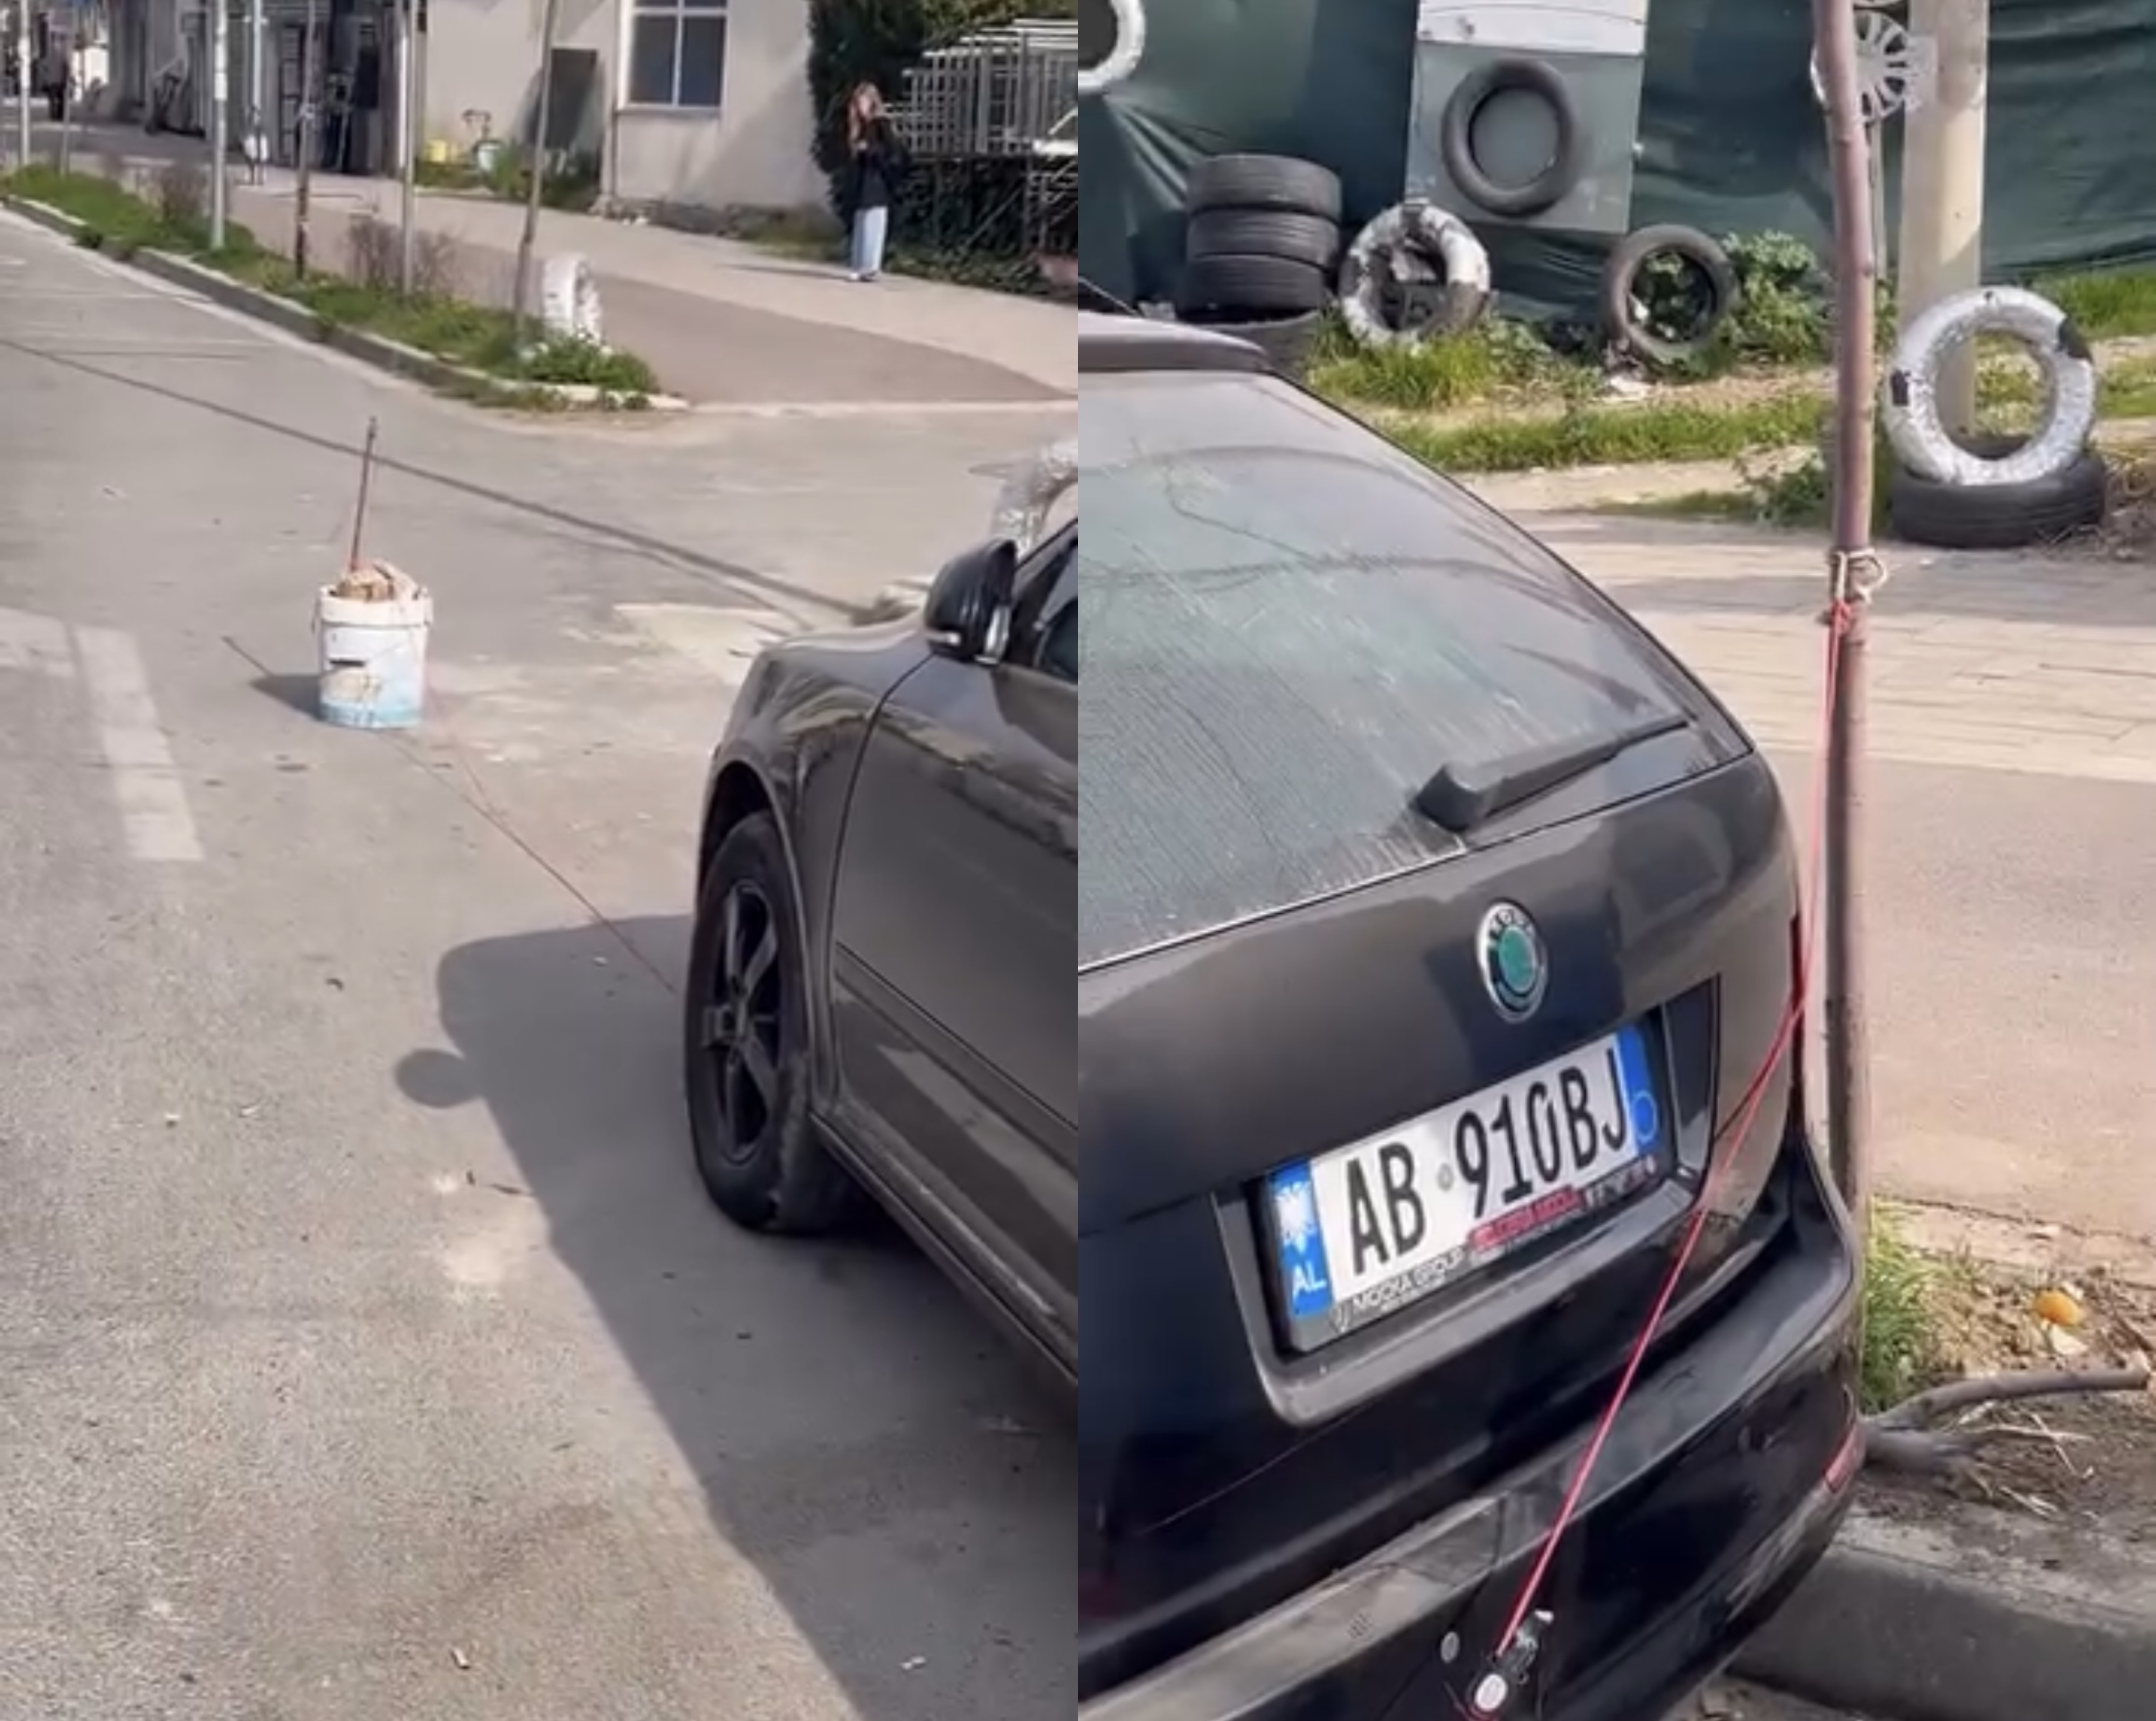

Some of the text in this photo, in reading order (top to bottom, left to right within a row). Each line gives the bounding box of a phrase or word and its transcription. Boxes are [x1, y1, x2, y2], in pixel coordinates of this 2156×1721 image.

[1345, 1142, 1425, 1275] AB
[1454, 1048, 1626, 1218] 910BJ
[1292, 1260, 1327, 1299] AL
